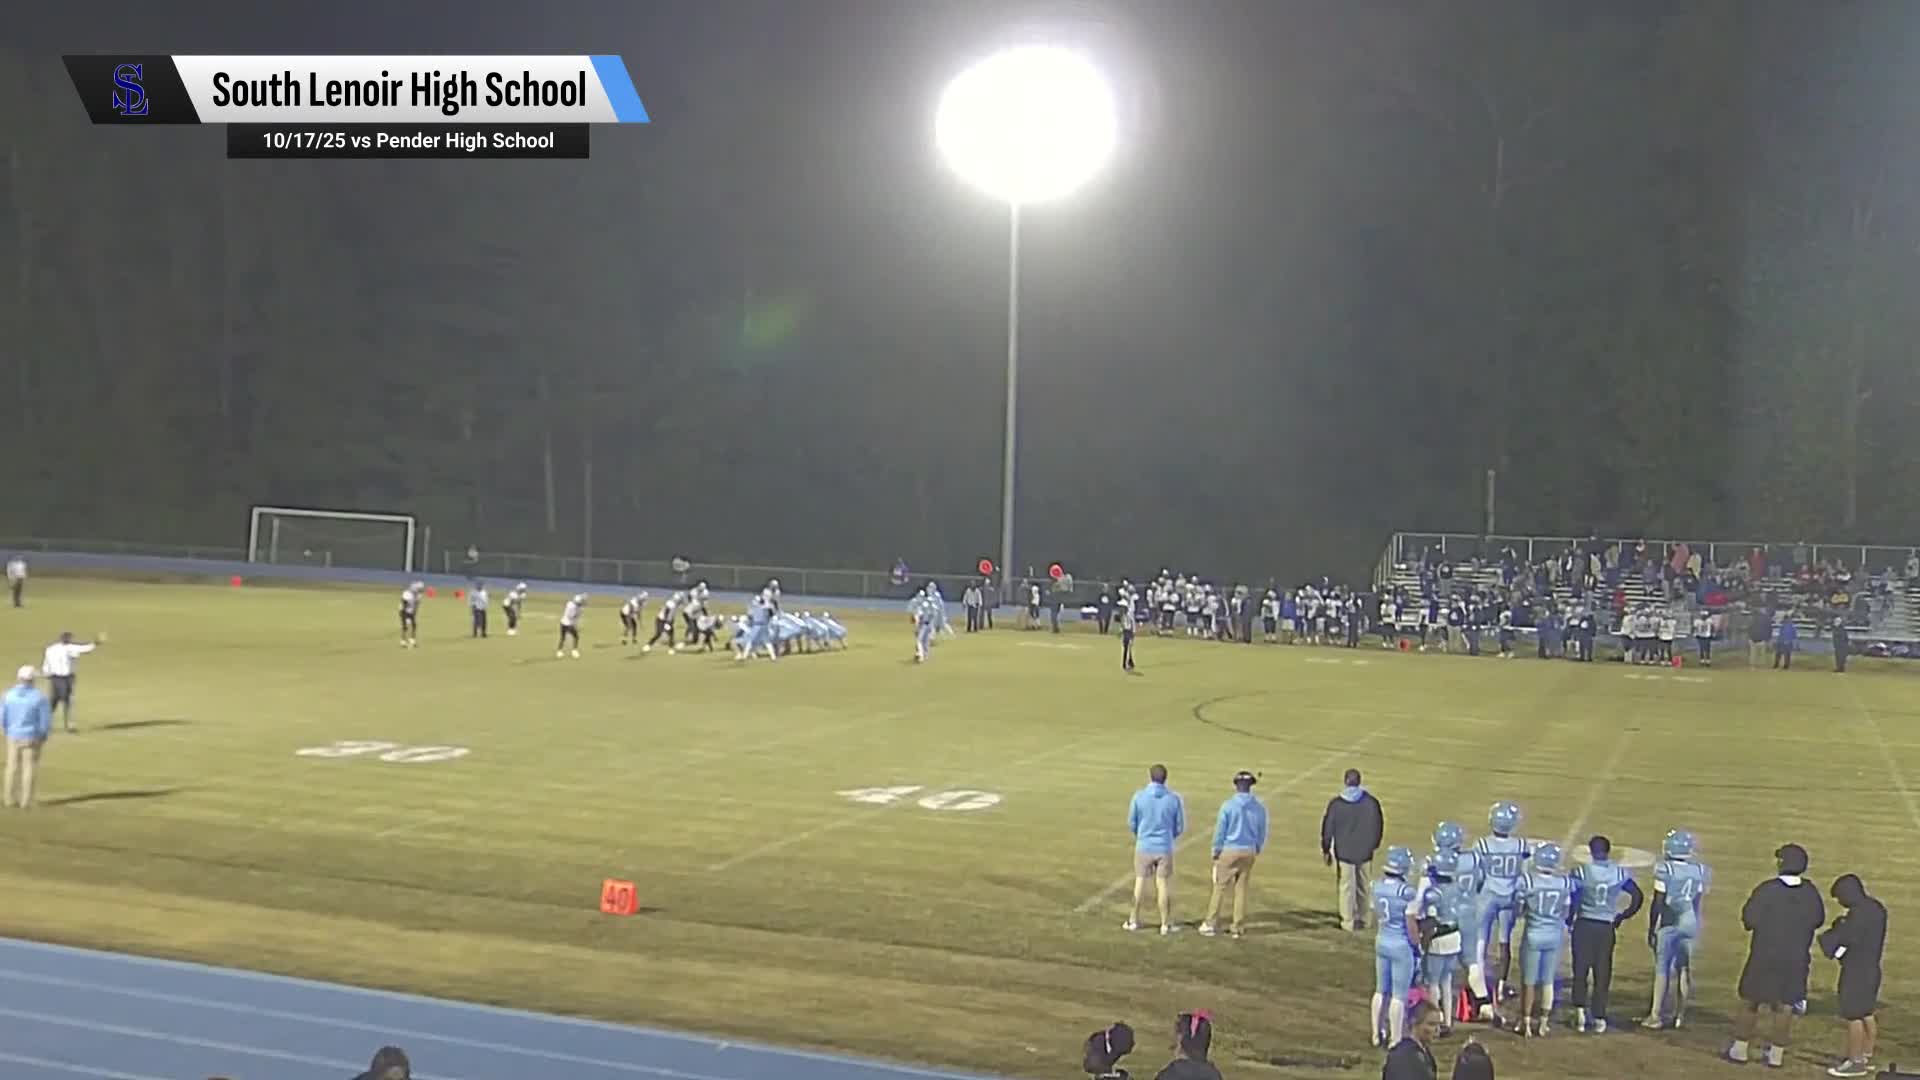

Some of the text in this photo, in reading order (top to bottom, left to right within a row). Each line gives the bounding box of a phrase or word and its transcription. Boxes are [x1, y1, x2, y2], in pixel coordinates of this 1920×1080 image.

[837, 785, 1003, 811] 40
[1491, 854, 1518, 876] 20
[604, 885, 629, 911] 40
[1680, 878, 1694, 902] 4
[1539, 891, 1561, 915] 17
